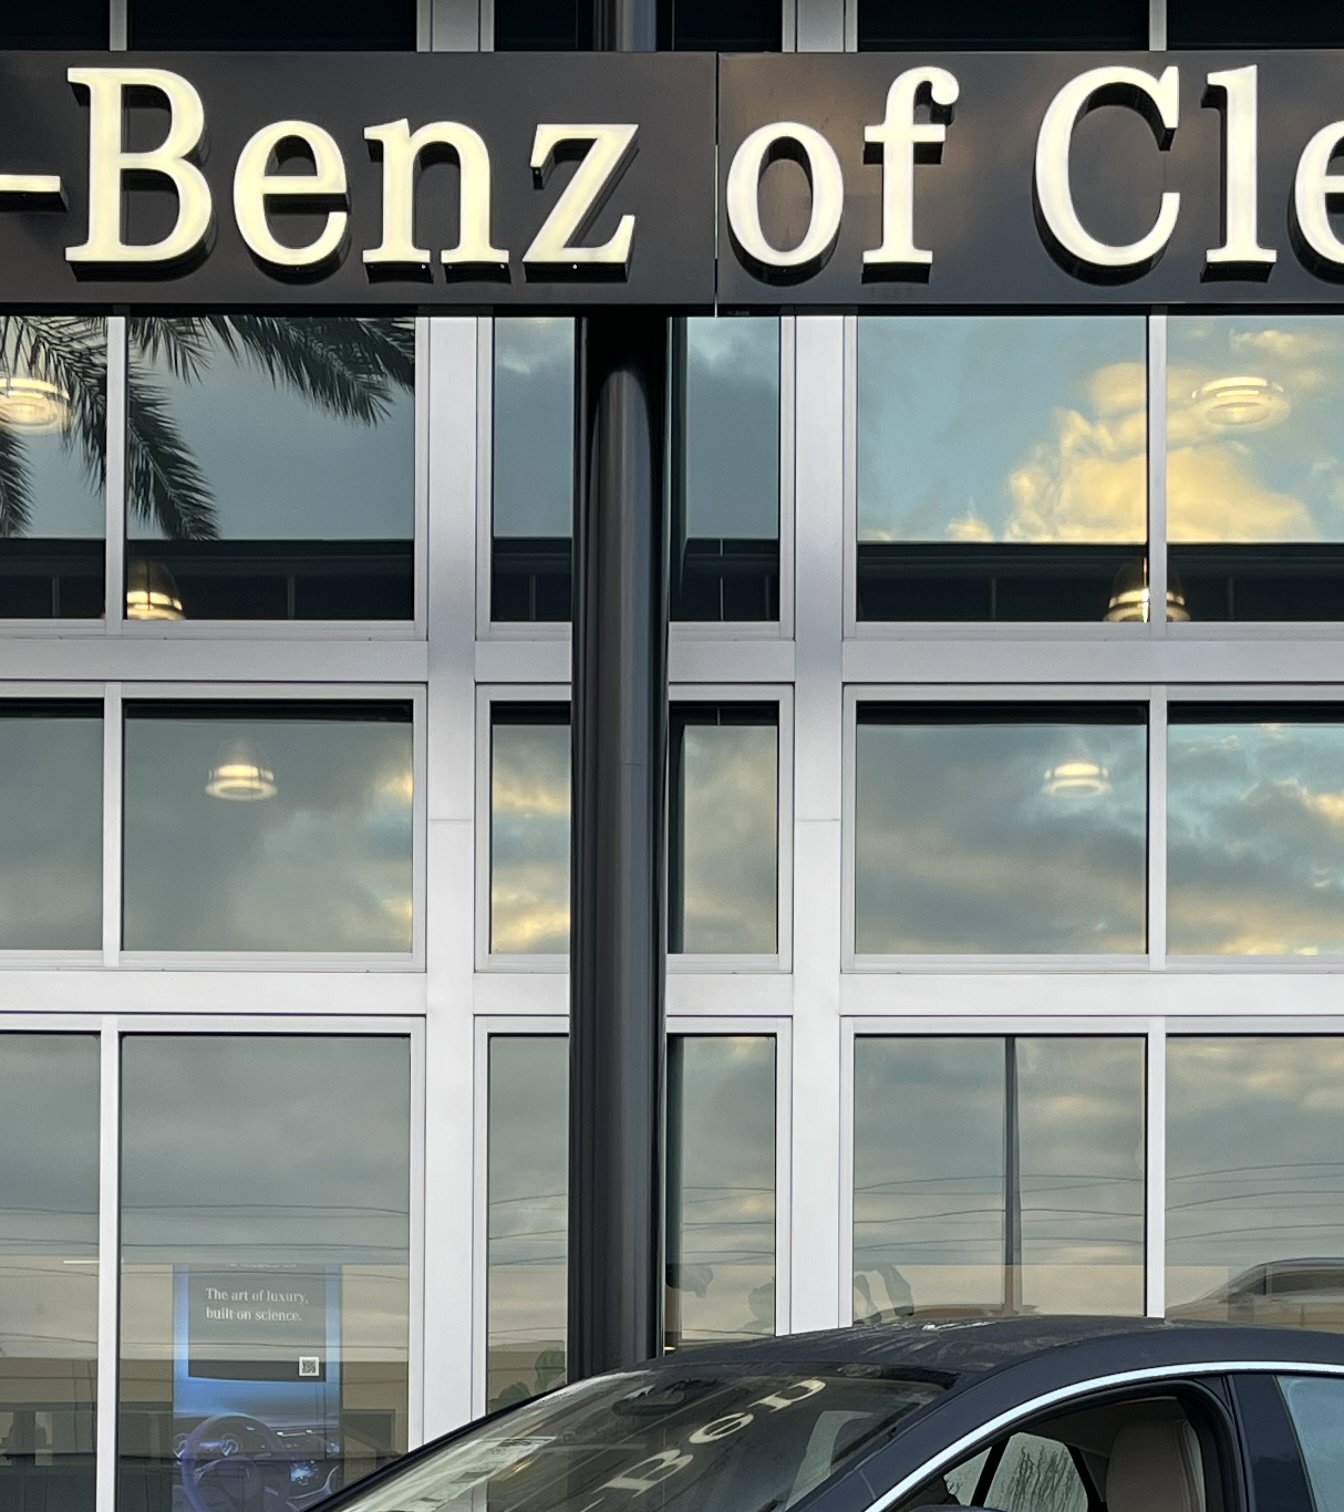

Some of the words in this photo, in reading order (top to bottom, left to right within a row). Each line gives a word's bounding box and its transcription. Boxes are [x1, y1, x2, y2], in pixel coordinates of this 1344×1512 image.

[726, 65, 960, 268] of
[206, 1287, 228, 1302] The
[231, 1289, 249, 1302] art
[251, 1289, 265, 1302] of
[267, 1289, 309, 1305] luxury,
[206, 1307, 234, 1320] built
[236, 1310, 252, 1321] on
[255, 1308, 302, 1322] science.
